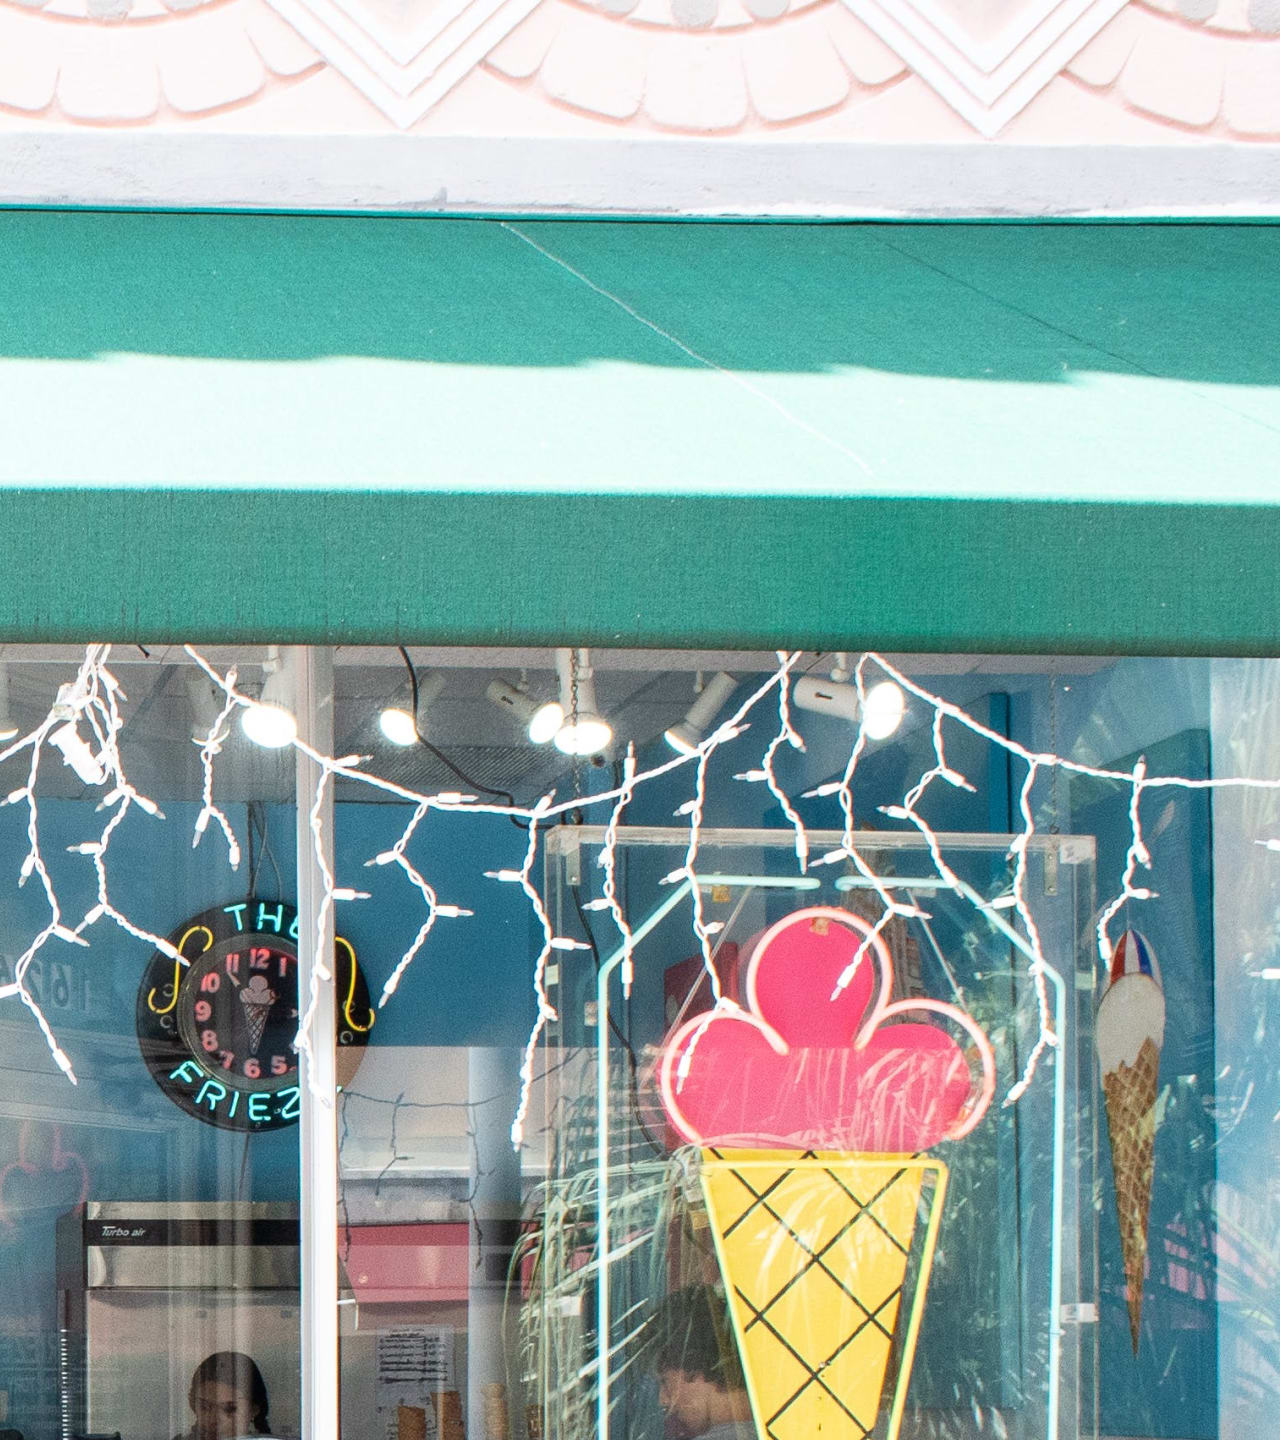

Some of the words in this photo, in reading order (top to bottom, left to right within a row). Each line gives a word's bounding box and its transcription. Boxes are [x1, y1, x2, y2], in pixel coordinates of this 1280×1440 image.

[168, 1060, 301, 1121] FRIEZ
[101, 1225, 130, 1237] Turbo
[130, 1228, 147, 1237] air
